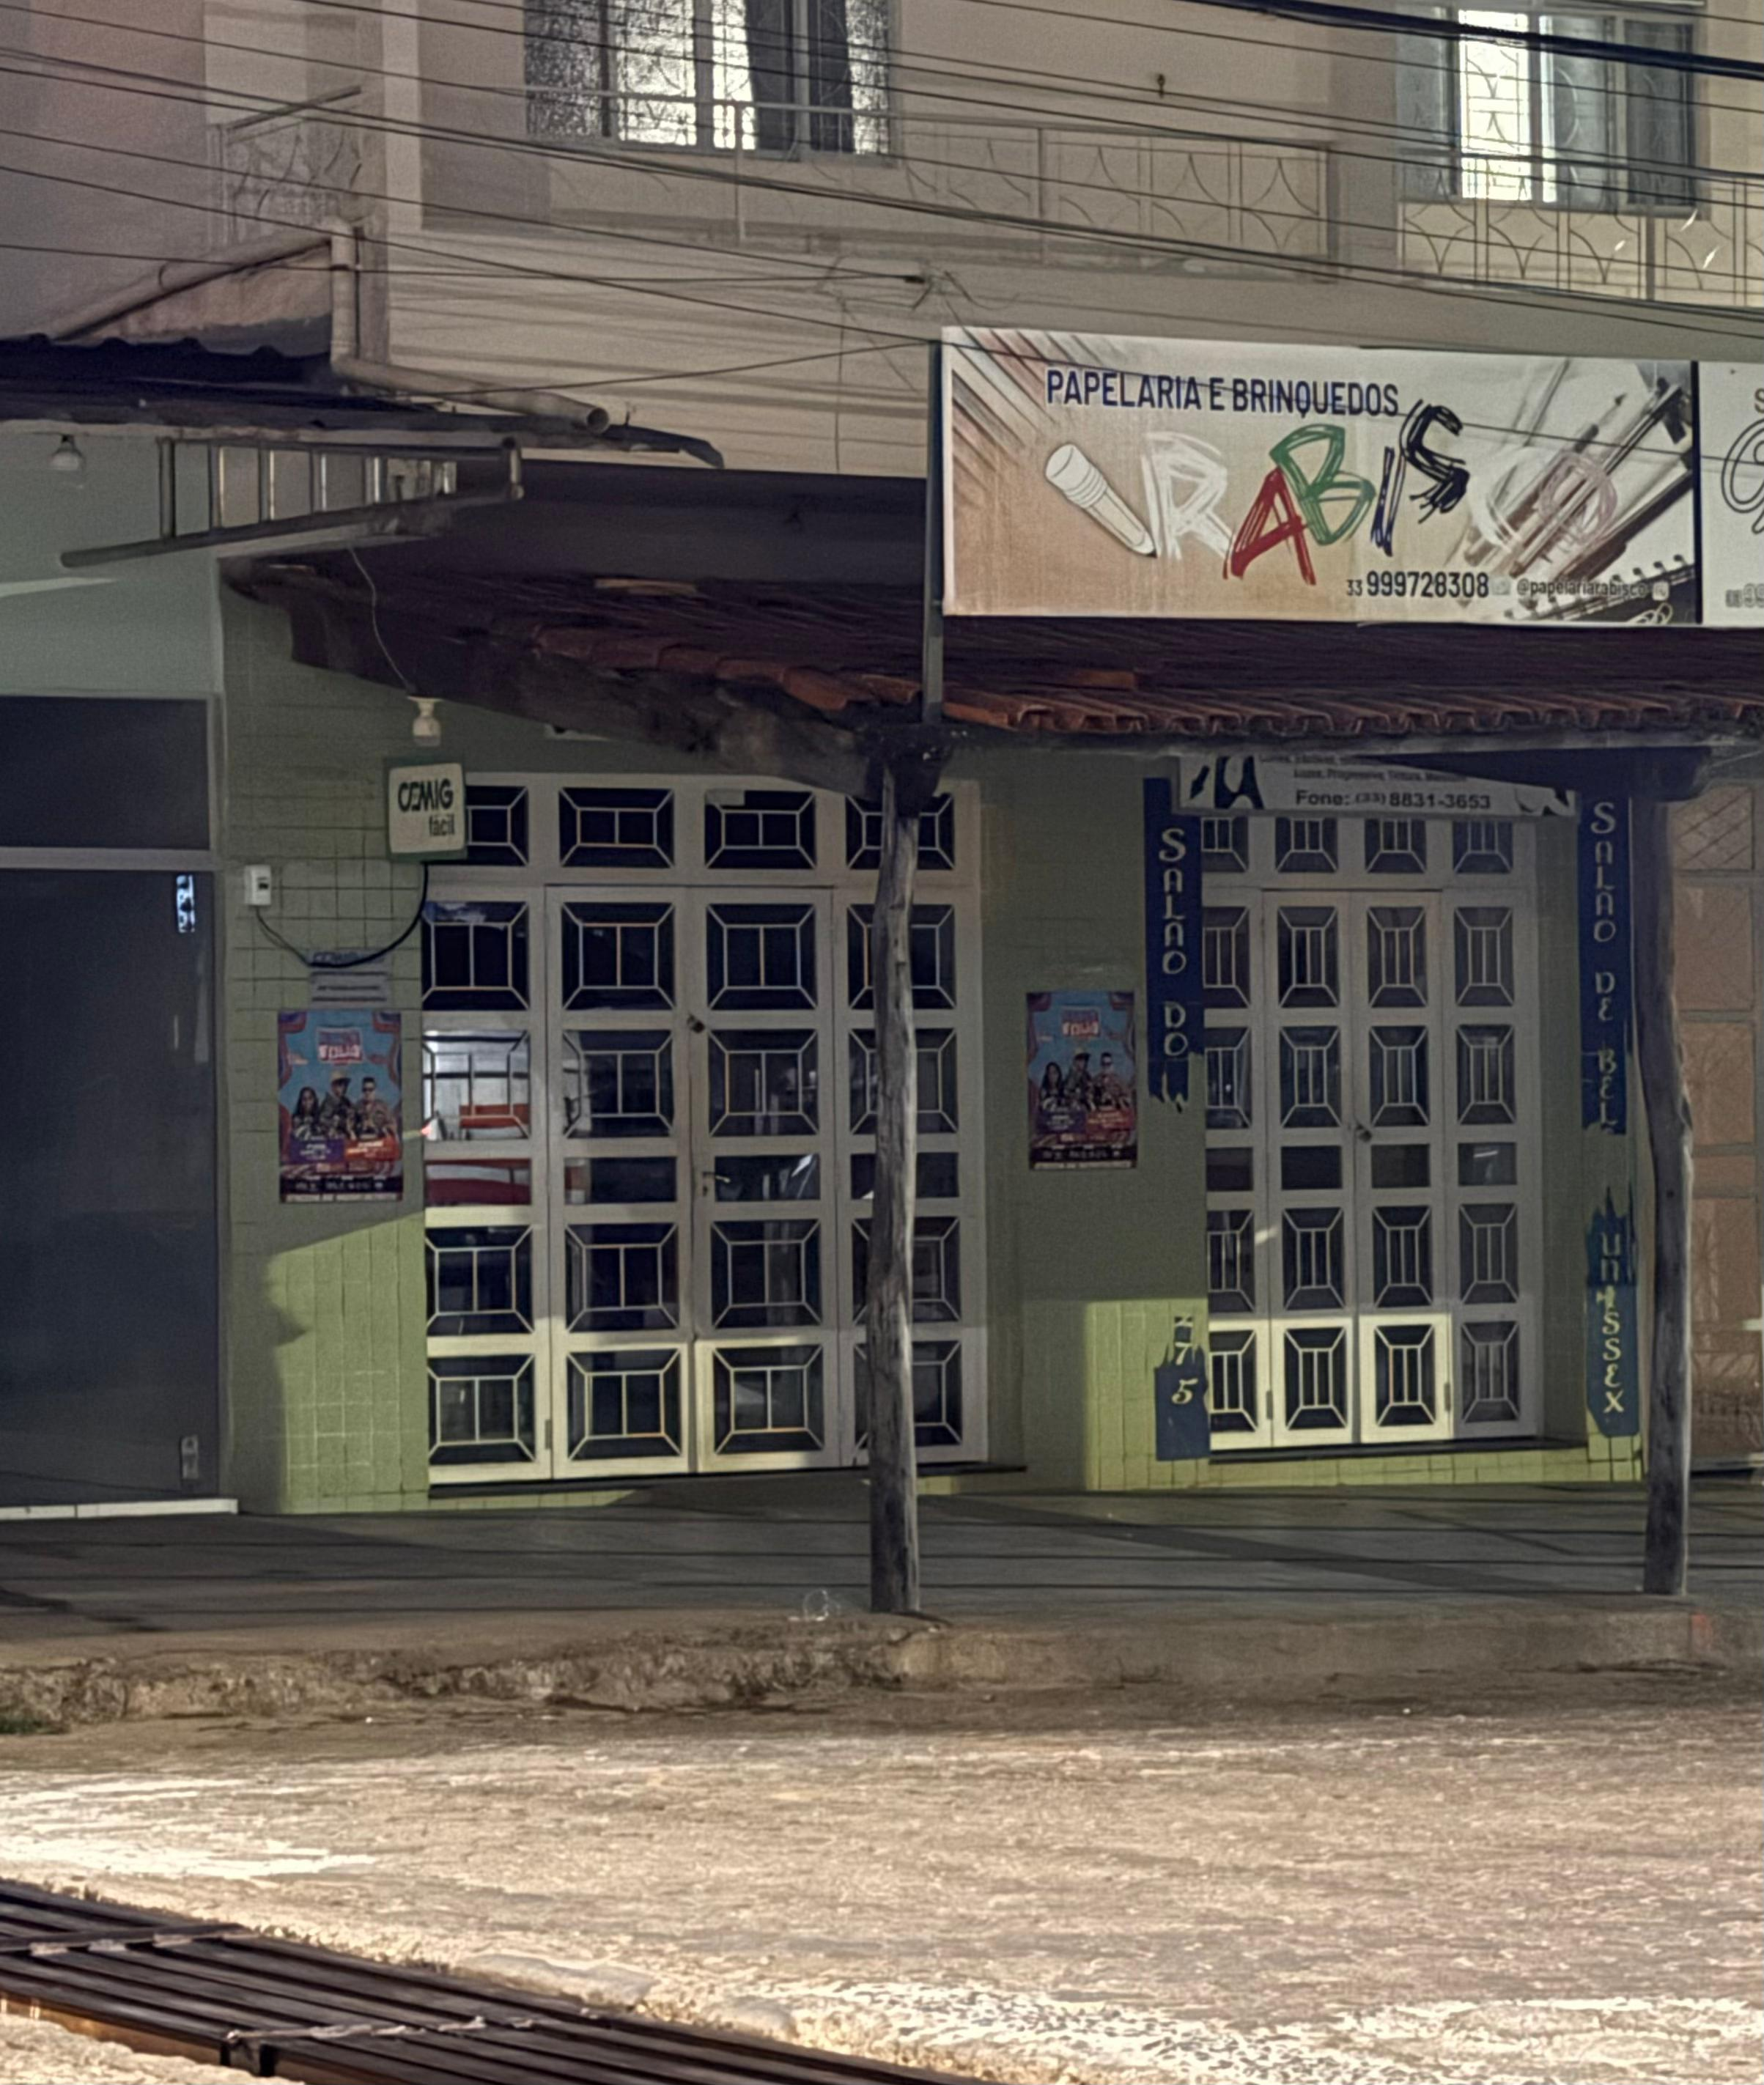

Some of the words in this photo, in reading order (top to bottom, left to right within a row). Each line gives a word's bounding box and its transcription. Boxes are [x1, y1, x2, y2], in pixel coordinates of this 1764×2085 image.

[1046, 369, 1202, 411] PAPELARIA
[1209, 377, 1225, 412] E
[1232, 377, 1400, 418] BRINQUEDOS
[1346, 579, 1363, 597] 33
[1367, 571, 1489, 599] 999728308
[398, 778, 454, 813] CEMIG
[1296, 789, 1350, 806] Fone:
[1389, 791, 1491, 810] 8831-3653
